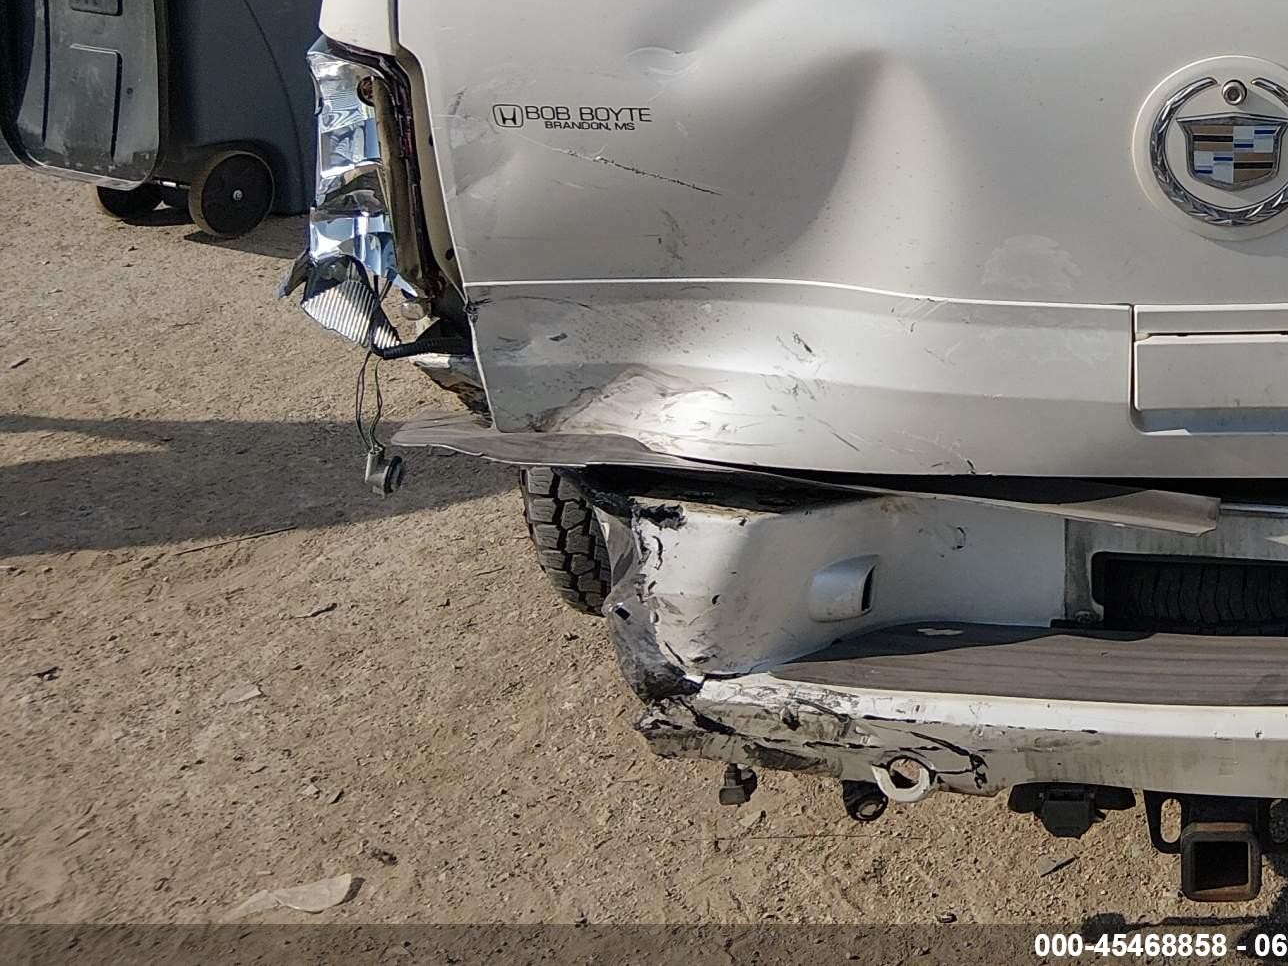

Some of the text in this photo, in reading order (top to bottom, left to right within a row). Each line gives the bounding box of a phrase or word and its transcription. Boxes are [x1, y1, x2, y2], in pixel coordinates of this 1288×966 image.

[525, 105, 571, 121] BOB
[579, 106, 652, 122] BOYTE
[545, 120, 636, 131] BRANDON, MS
